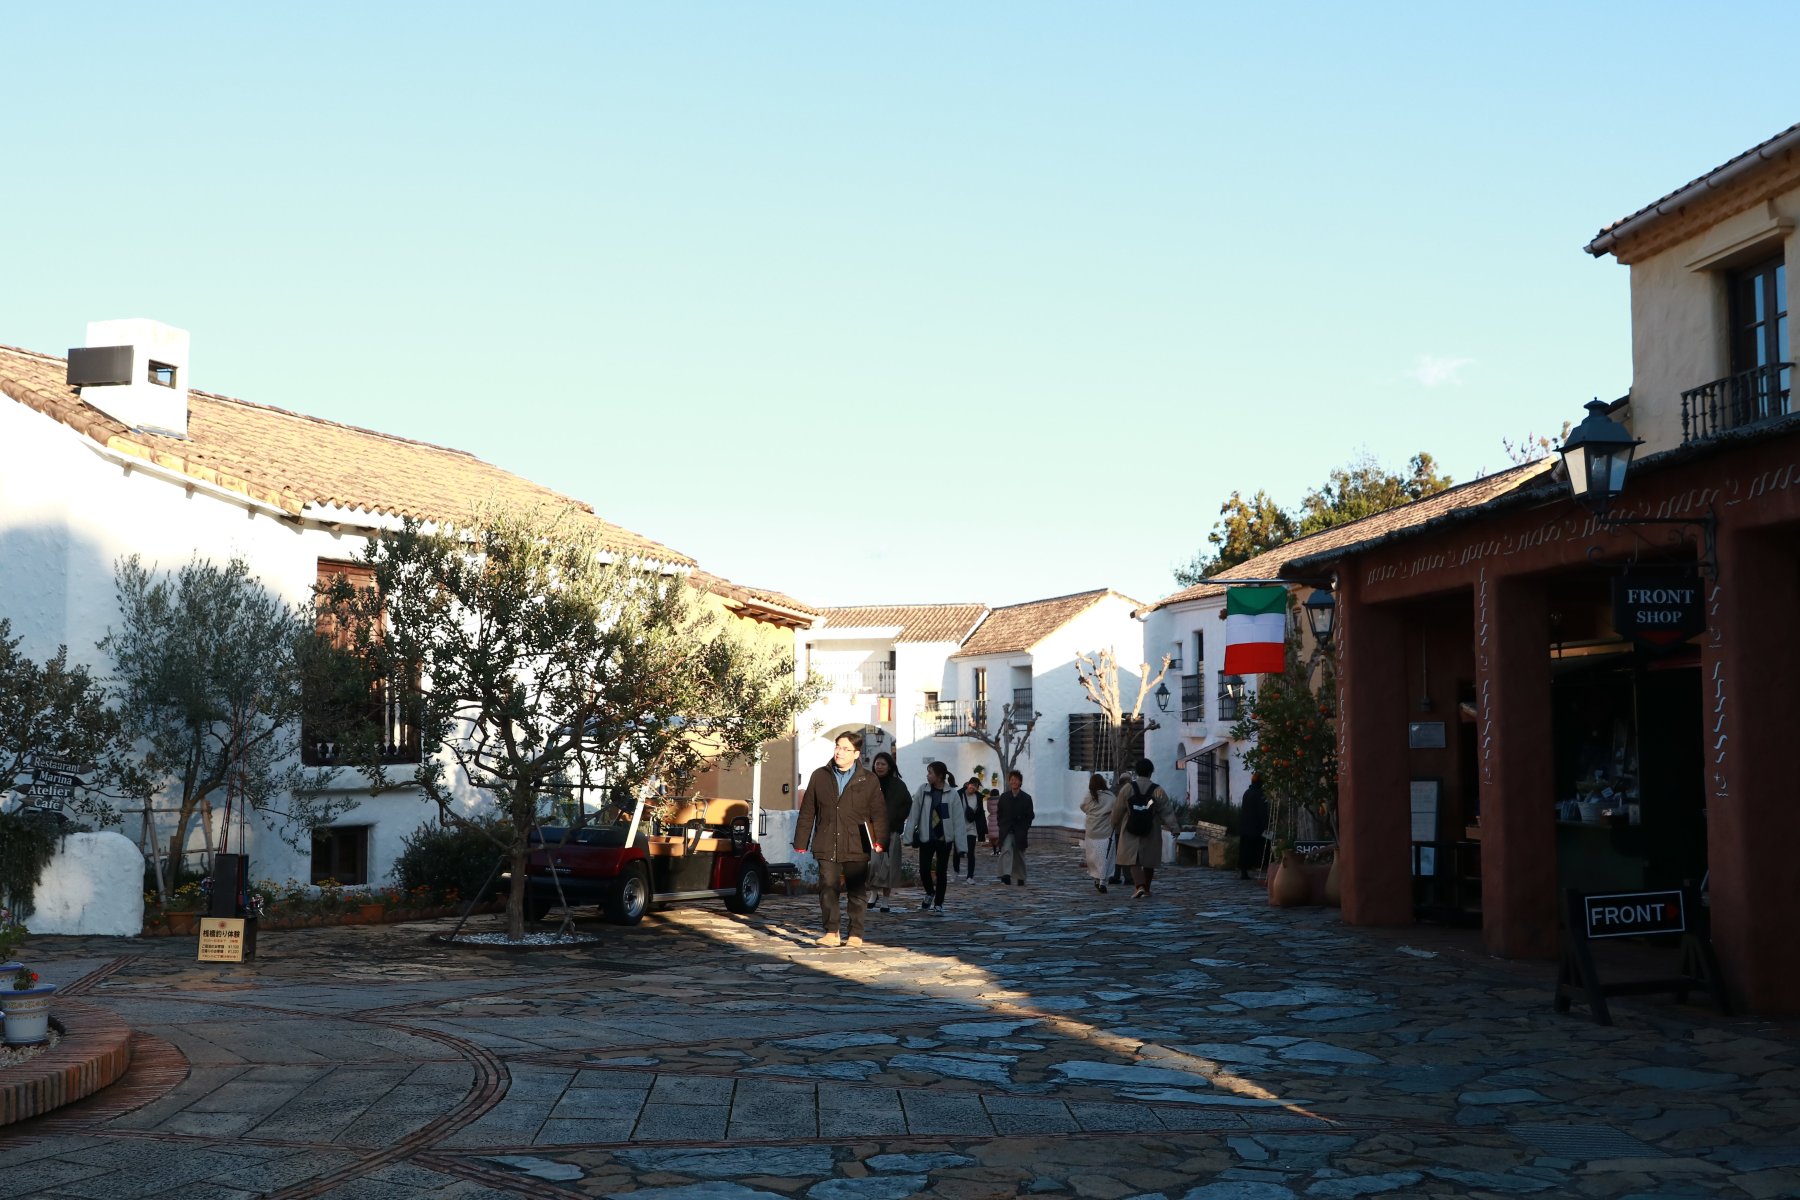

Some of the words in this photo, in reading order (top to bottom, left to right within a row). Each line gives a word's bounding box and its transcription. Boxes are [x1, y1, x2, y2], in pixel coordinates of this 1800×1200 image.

[1626, 589, 1695, 604] FRONT
[1636, 610, 1683, 624] SHOP
[34, 757, 81, 773] Restaurant
[39, 771, 73, 786] Marina
[28, 785, 71, 797] Atelier
[34, 797, 60, 810] Café
[1591, 903, 1665, 926] FRONT
